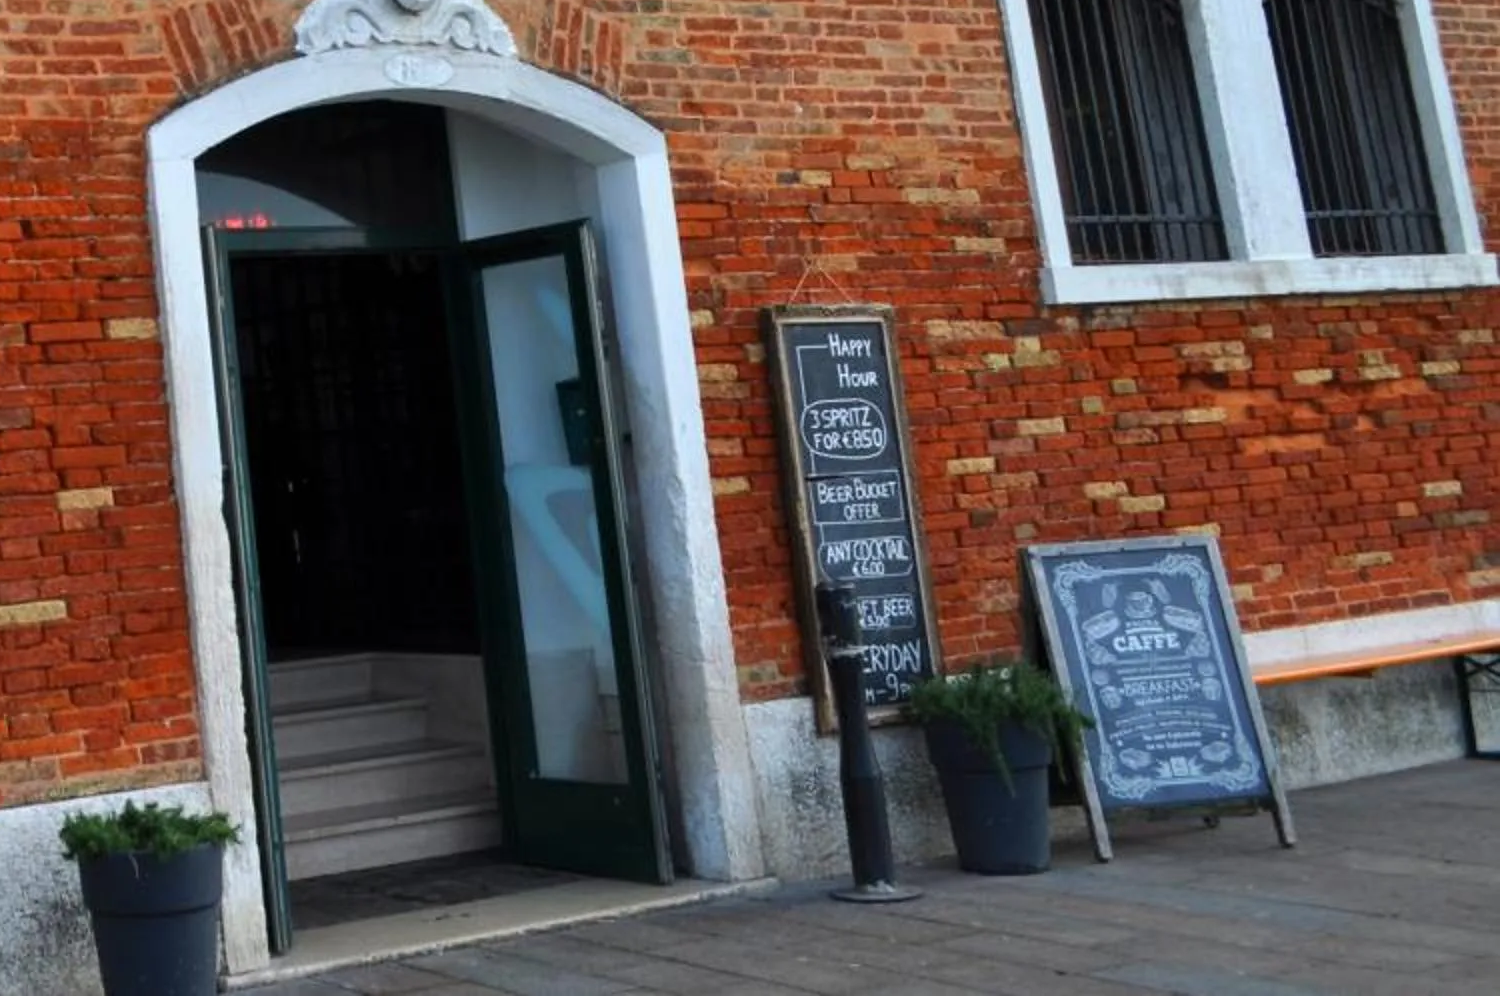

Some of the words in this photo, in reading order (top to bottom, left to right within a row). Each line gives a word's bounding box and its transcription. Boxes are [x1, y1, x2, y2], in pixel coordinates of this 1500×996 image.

[809, 409, 821, 429] 3
[821, 406, 872, 429] SPRITZ
[813, 431, 841, 450] FOR
[817, 483, 854, 504] BEER
[843, 502, 881, 521] OFFER
[826, 540, 852, 564] ANY
